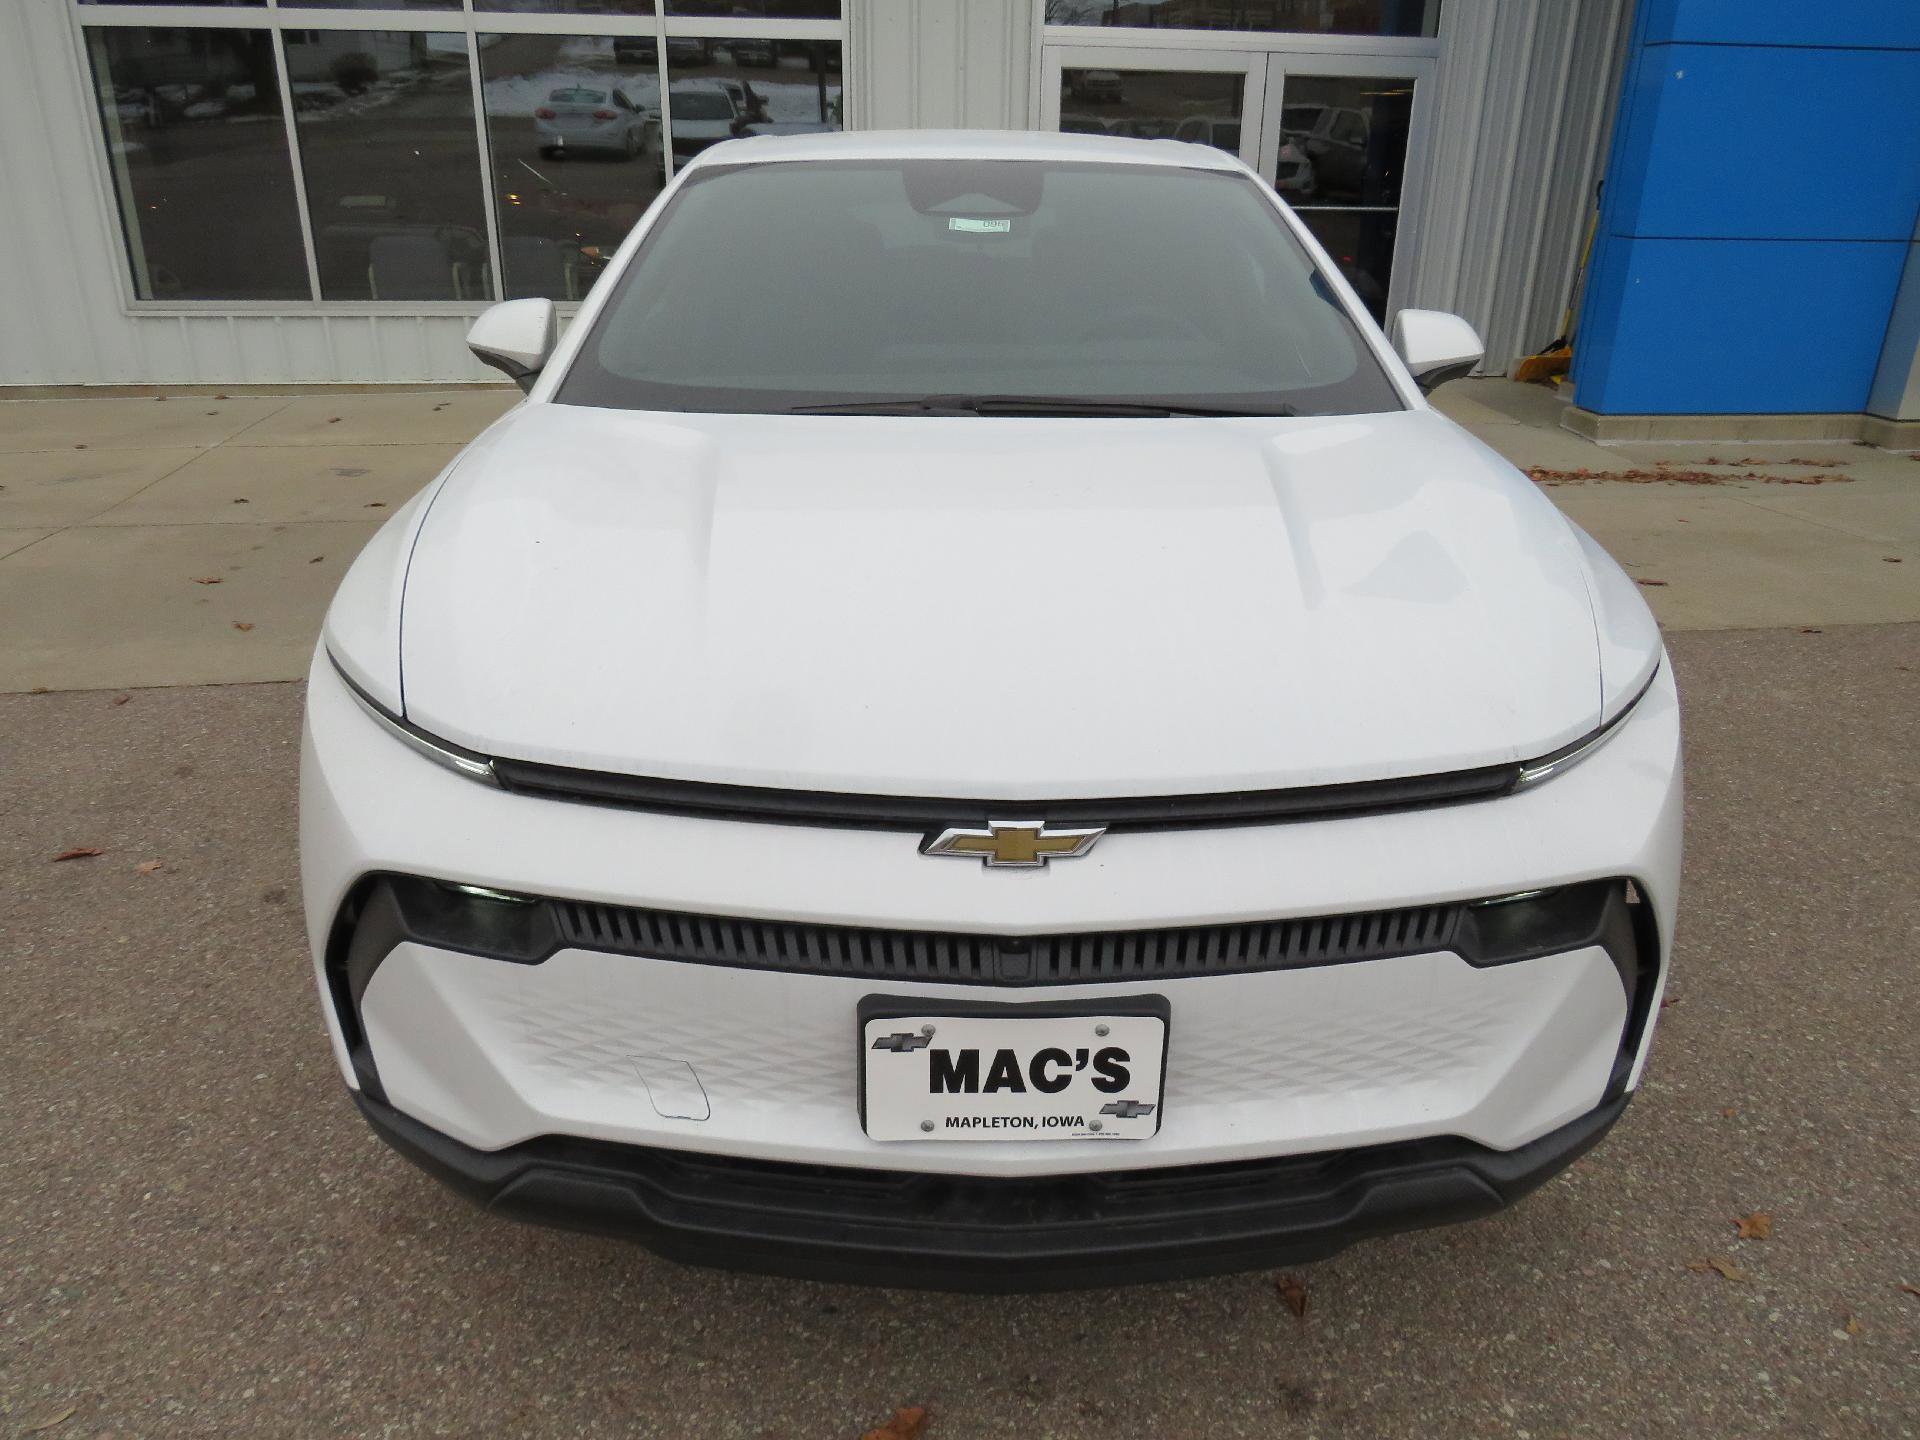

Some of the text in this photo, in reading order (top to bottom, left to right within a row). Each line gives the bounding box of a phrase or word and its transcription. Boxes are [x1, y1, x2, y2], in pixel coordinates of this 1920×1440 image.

[929, 1047, 1131, 1094] MAC'S
[945, 1115, 1085, 1130] MAPLETON, IOWA
